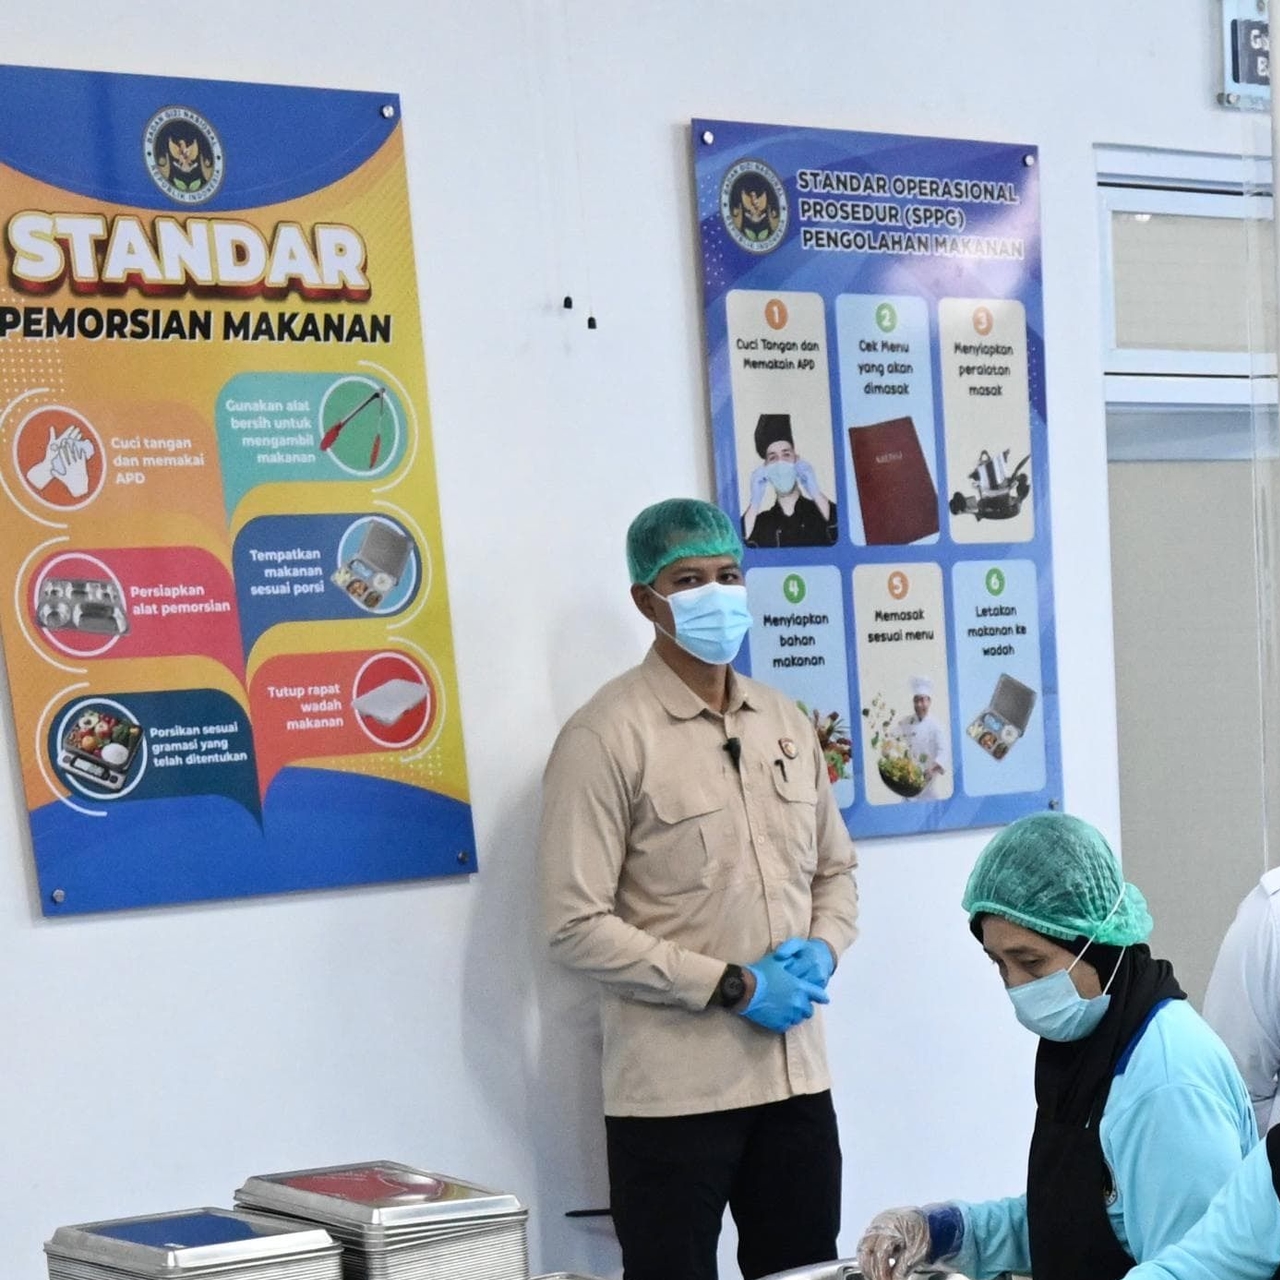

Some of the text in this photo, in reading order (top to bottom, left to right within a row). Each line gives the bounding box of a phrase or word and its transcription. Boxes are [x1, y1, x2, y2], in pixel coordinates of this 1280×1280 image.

[797, 170, 1019, 203] STANDAR OPERASIONAL
[800, 201, 966, 229] PROSEDUR (SPPG)
[802, 229, 1025, 260] PENGOLAHAN MAKANAN
[7, 210, 370, 295] STANDAR
[880, 309, 892, 325] 2
[977, 311, 989, 329] 3
[0, 307, 391, 342] PEMORSIAN MAKANAN
[736, 339, 819, 353] Cuci Tangan dan
[859, 341, 909, 353] Cek Menu
[954, 342, 1014, 356] Menyiapkan
[797, 358, 815, 370] APD
[858, 362, 913, 376] yang akan
[958, 363, 1011, 378] peralatan
[863, 382, 909, 395] dimasak
[969, 384, 1003, 396] masak
[226, 400, 310, 412] Gunakan alat
[231, 417, 312, 429] bersih untuk
[111, 437, 192, 451] Cuci tangan
[242, 434, 314, 449] mengambil
[113, 454, 205, 467] dan memakai
[257, 451, 316, 464] makanan
[115, 472, 145, 485] APD
[250, 548, 321, 564] Tempatkan
[264, 566, 323, 578] makanan
[787, 579, 799, 597] 4
[892, 575, 903, 594] 5
[990, 572, 1001, 590] 6
[131, 584, 205, 600] Persiapkan
[250, 581, 325, 596] sesuai porsi
[132, 600, 231, 615] alat pemorsian
[975, 604, 1017, 617] Letakan
[763, 613, 829, 628] Menyiapkan
[875, 610, 925, 622] Memasak
[868, 630, 934, 643] sesuai menu
[967, 623, 1027, 637] makanan ke
[779, 634, 815, 647] bahan
[982, 644, 1015, 656] wadah
[773, 655, 825, 668] makanan
[267, 684, 341, 700] Tutup rapat
[301, 700, 342, 713] wadah
[150, 722, 239, 739] Porsikan sesuai
[287, 717, 344, 730] makanan
[152, 738, 229, 755] gramasi yang
[153, 750, 248, 767] telah ditentukan
